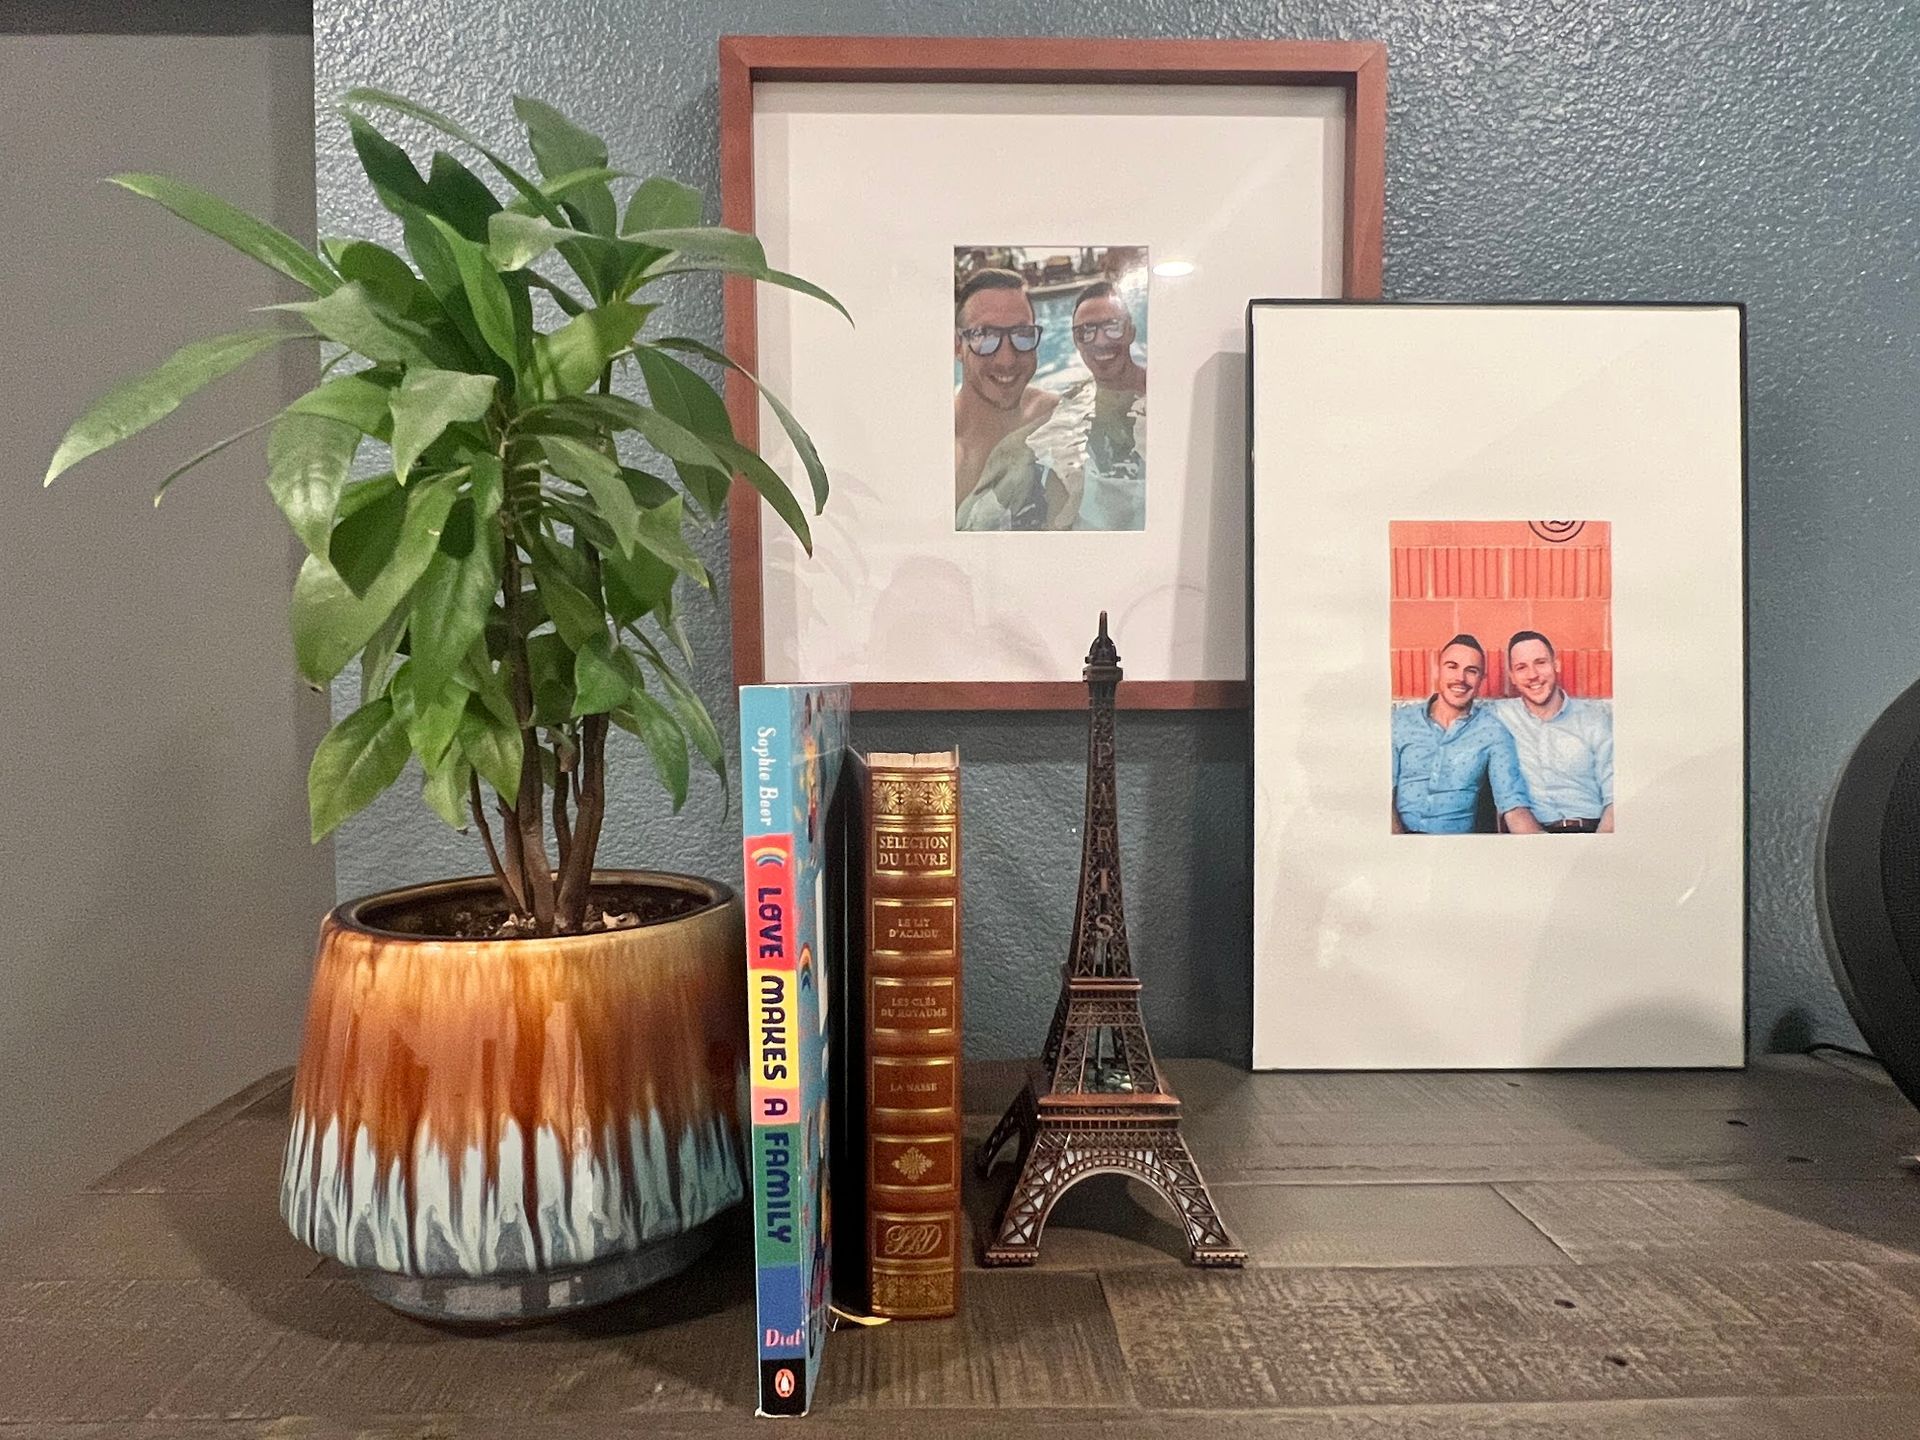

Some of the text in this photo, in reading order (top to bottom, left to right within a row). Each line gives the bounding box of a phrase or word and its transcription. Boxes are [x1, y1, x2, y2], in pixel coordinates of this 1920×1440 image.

[752, 726, 778, 826] Sophie Beer
[879, 853, 948, 865] DU LIVRE
[898, 918, 911, 927] LE
[891, 998, 909, 1007] LES
[881, 1008, 895, 1017] DU
[758, 887, 792, 1244] LOVE MAKES A FAMILY
[890, 1083, 902, 1092] LA
[765, 1328, 802, 1348] Dial
